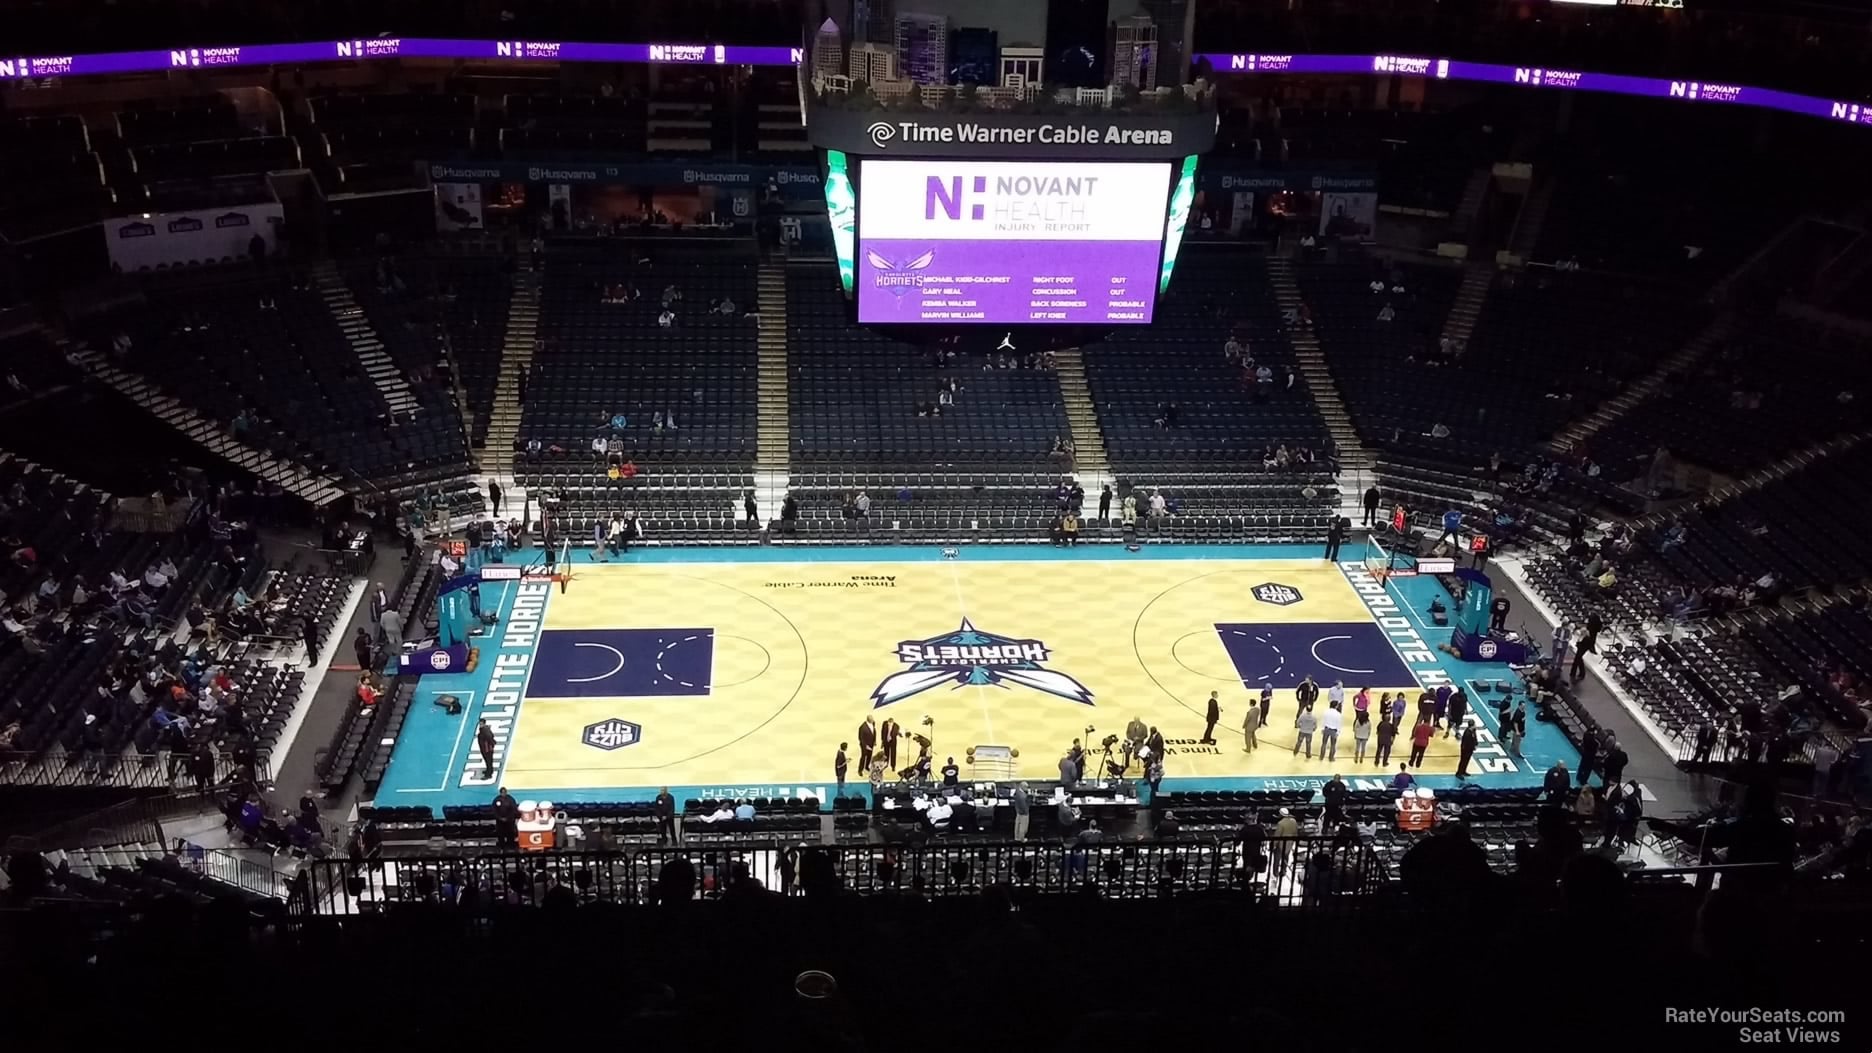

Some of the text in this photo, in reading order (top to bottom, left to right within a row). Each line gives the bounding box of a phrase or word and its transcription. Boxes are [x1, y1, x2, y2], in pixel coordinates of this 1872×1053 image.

[366, 40, 400, 48] NOVANT
[526, 43, 560, 51] NOVANT
[204, 48, 240, 56] NOVANT
[366, 46, 398, 55] HEALTH
[32, 57, 73, 66] NOVANT
[204, 56, 238, 64] HEALTH
[672, 53, 704, 61] HEALTH
[33, 65, 72, 74] HEALTH
[1258, 62, 1288, 70] HEALTH
[1395, 64, 1426, 74] HEALTH
[1545, 70, 1582, 80] NOVANT
[1544, 78, 1577, 87] HEALTH
[1703, 84, 1742, 95] NOVANT
[1702, 92, 1736, 100] HEALTH
[899, 122, 1173, 145] Time Warner Cable Arena
[444, 168, 500, 178] Husqvarna
[540, 170, 597, 180] Husqvarna
[695, 172, 750, 182] Husqvarna
[996, 176, 1099, 196] NOVANT
[994, 201, 1086, 221] HEALTH
[994, 223, 1091, 232] INJURY REPORT
[876, 275, 923, 287] HORNETS
[1259, 585, 1292, 594] CITY
[1260, 593, 1297, 603] BUZZ
[1340, 561, 1438, 663] CHARLOTTE
[900, 643, 1046, 662] HORNETS
[594, 722, 632, 734] CITY
[589, 734, 633, 746] BUZZ
[1182, 747, 1224, 755] Time
[702, 788, 772, 797] HEALTH
[1409, 814, 1422, 824] G
[530, 833, 542, 844] G
